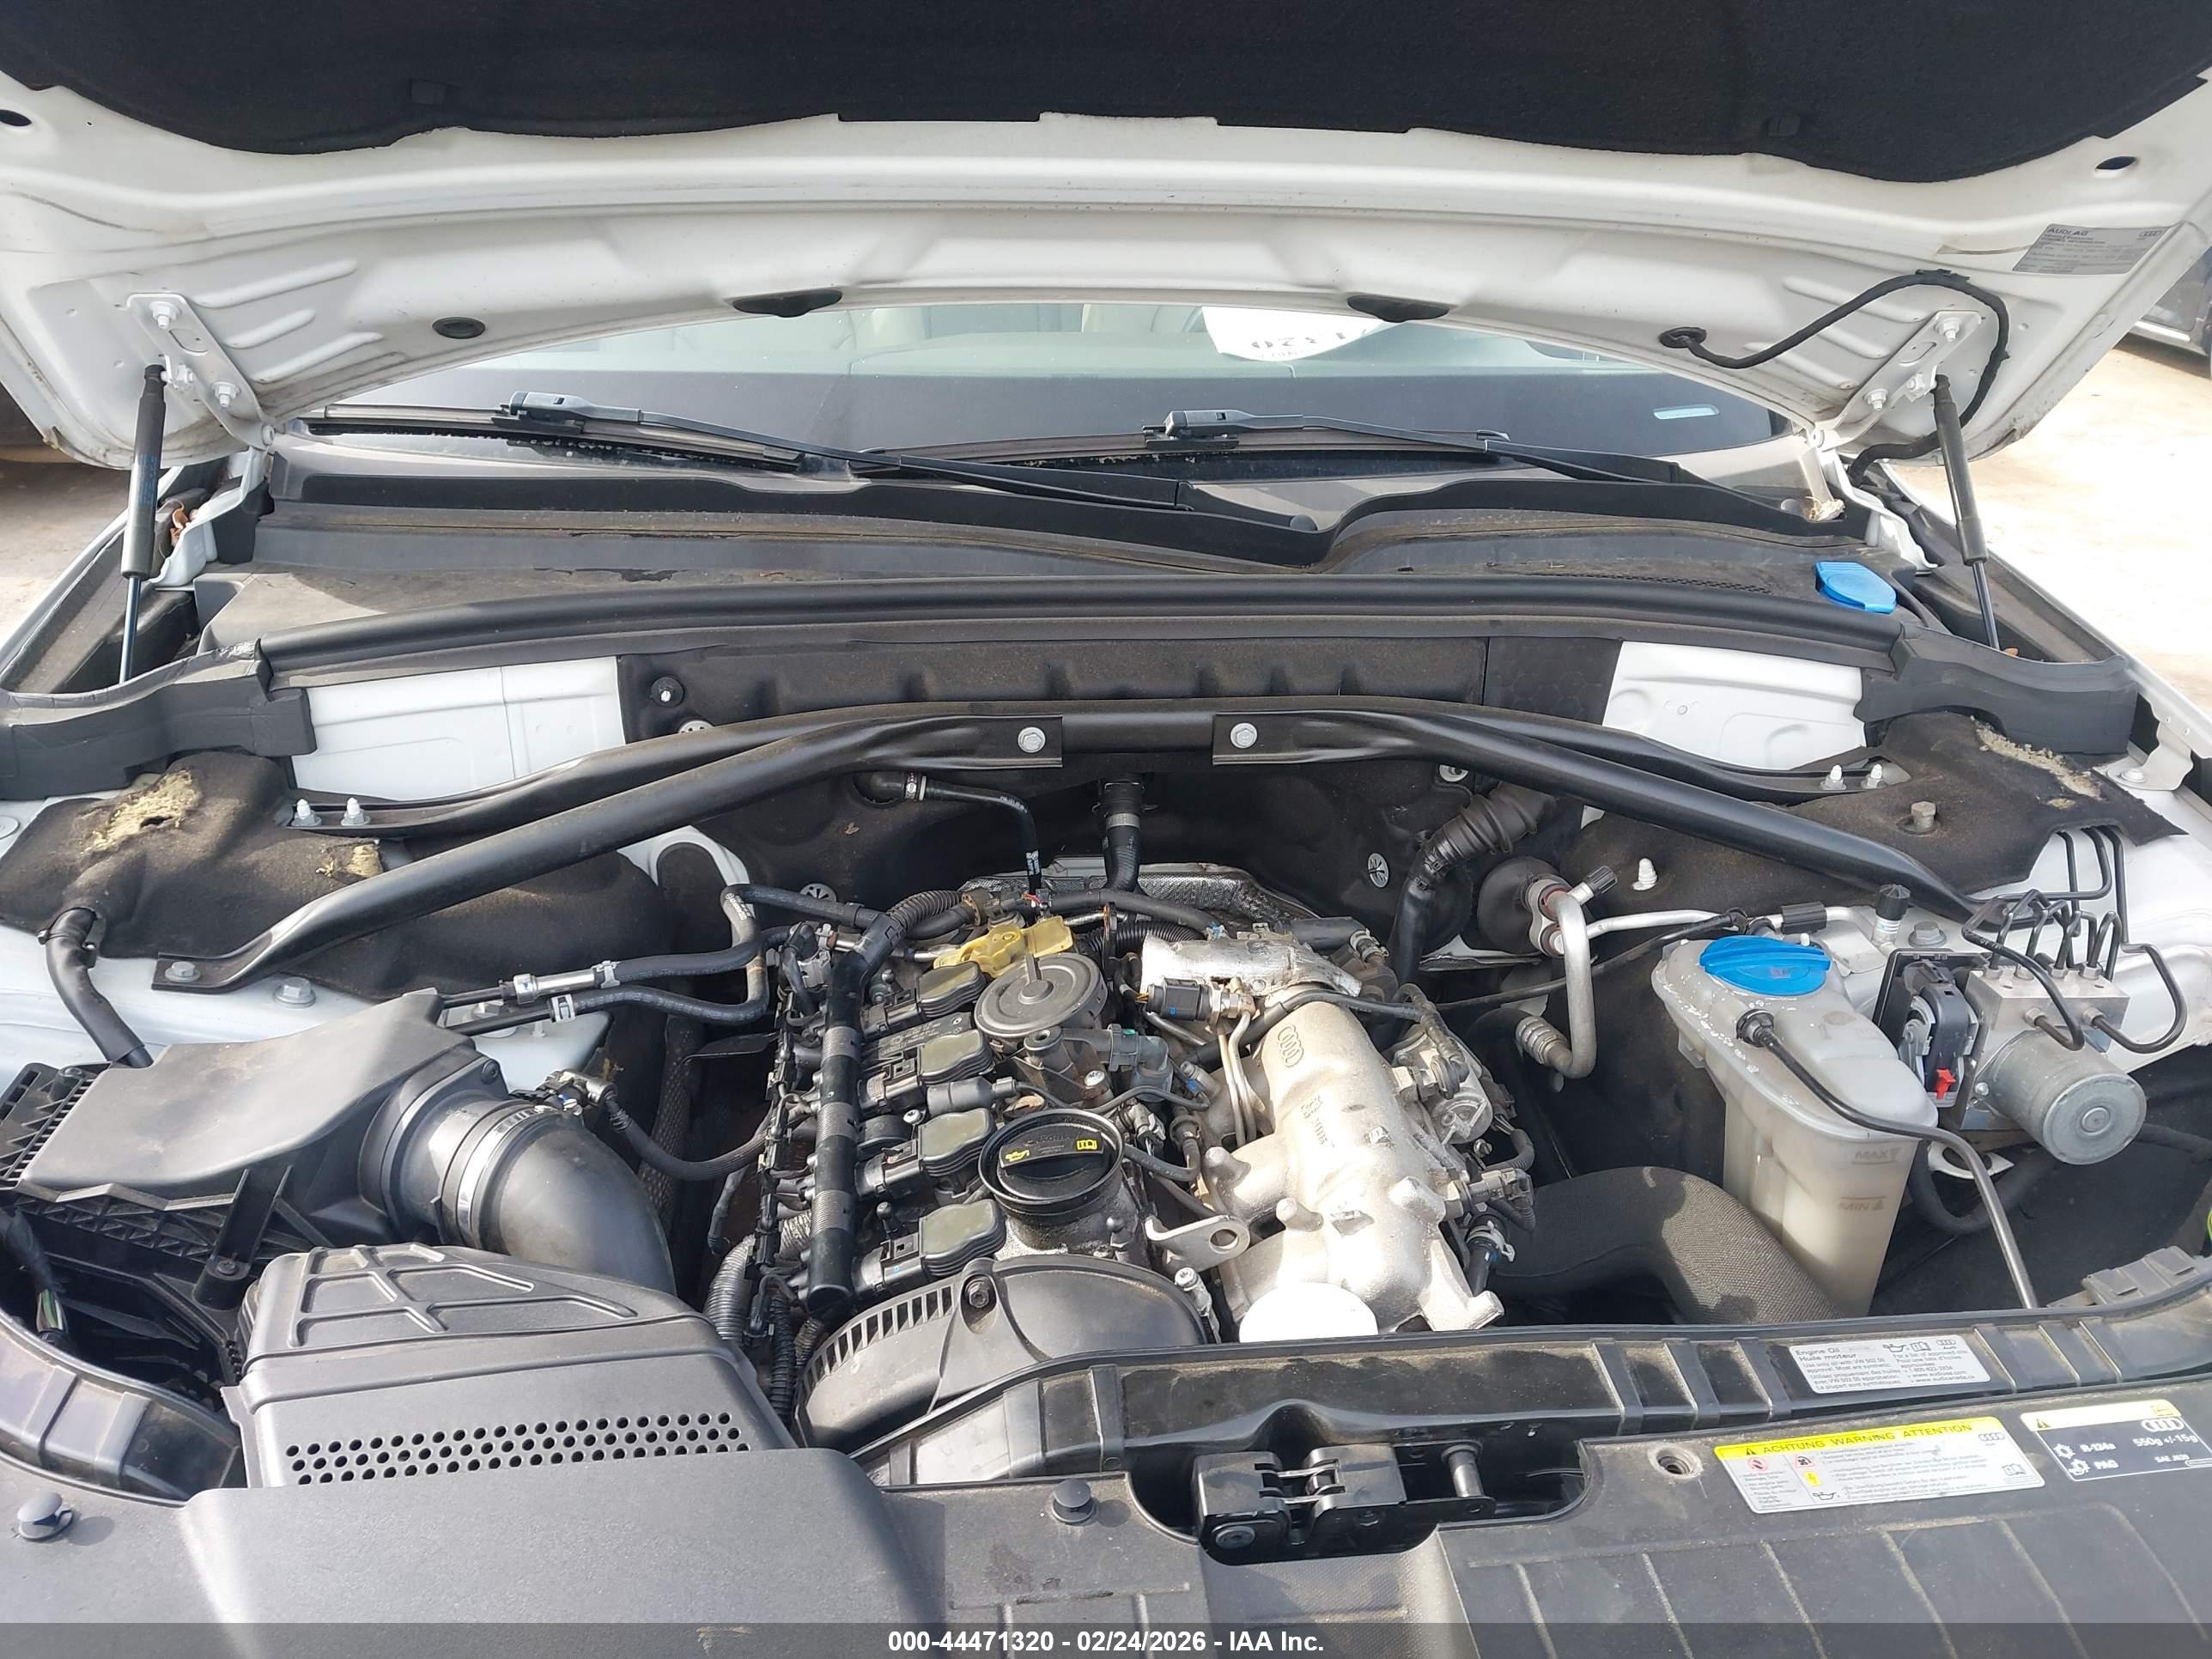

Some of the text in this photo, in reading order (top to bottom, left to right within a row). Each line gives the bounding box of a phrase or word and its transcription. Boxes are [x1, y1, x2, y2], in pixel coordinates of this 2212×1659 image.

[1855, 1150, 1889, 1159] MAX
[1839, 1202, 1869, 1212] MIN
[1763, 1440, 1825, 1454] ACHTUNG
[1830, 1432, 1895, 1446] WARNING
[1903, 1424, 1972, 1438] ATTENTION
